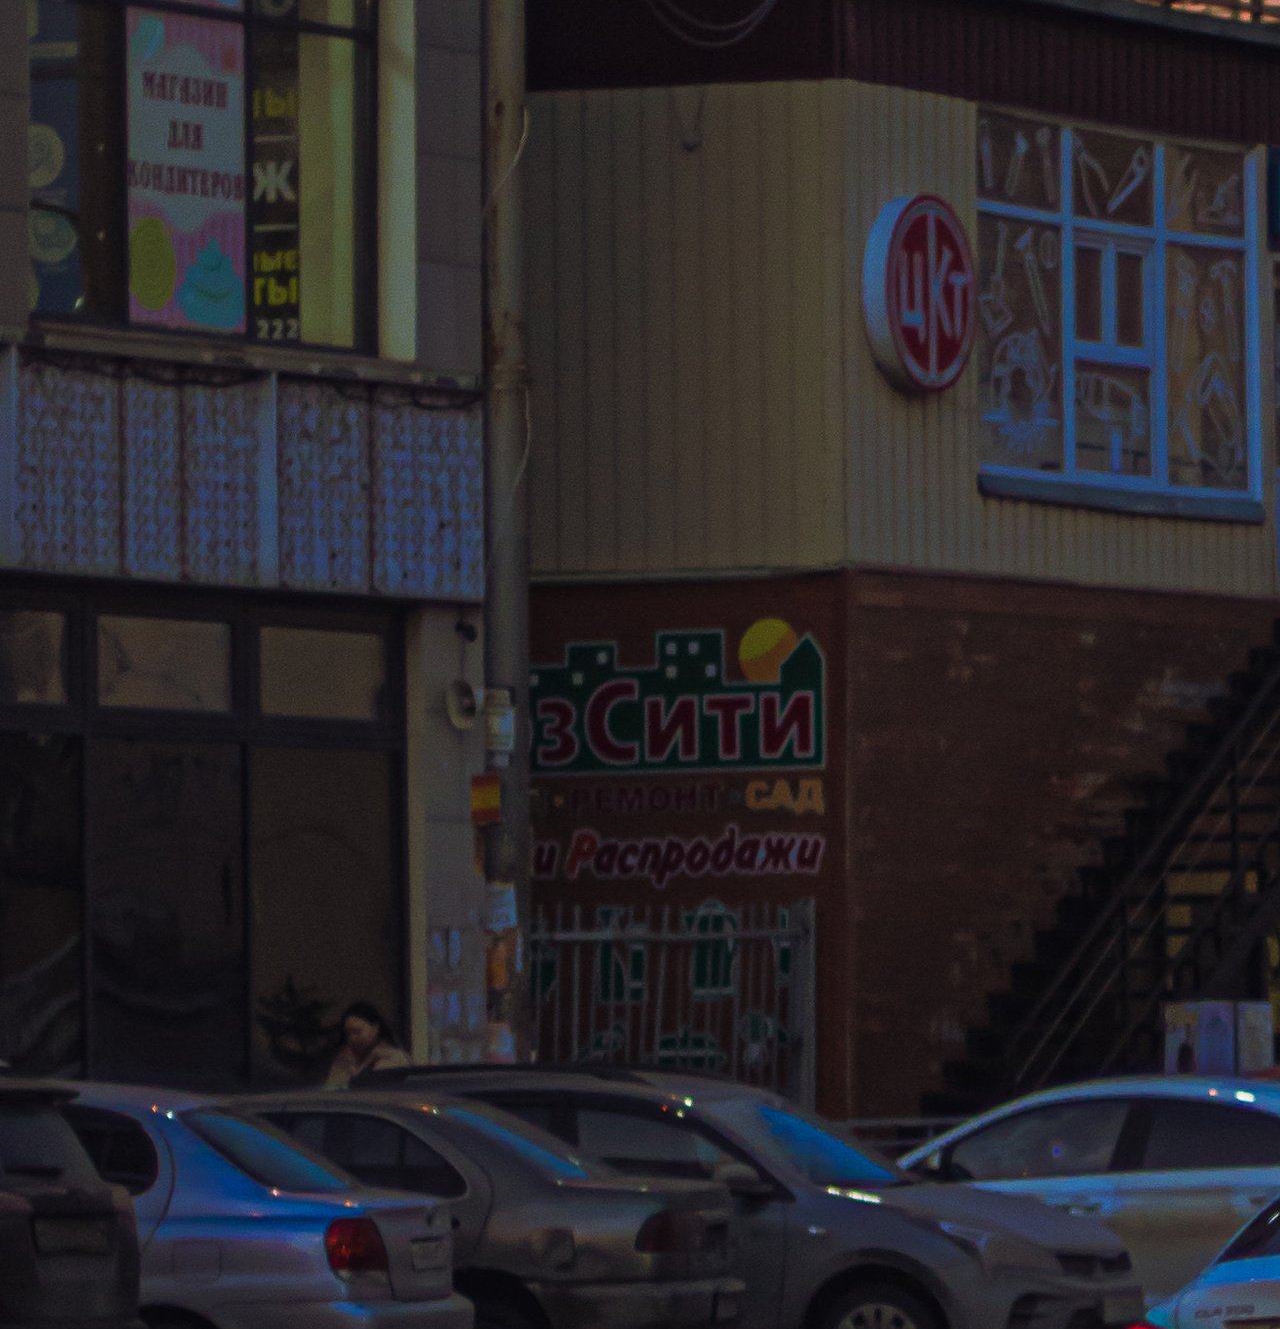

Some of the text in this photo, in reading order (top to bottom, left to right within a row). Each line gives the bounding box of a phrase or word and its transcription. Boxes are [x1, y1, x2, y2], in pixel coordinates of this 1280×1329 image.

[142, 71, 228, 109] МАГАЗИН
[167, 120, 204, 152] ДЛЯ
[127, 158, 245, 201] КОНДИТЕРОВ
[571, 778, 826, 816] РЕМОНТ САД
[566, 821, 826, 889] Распродажи
